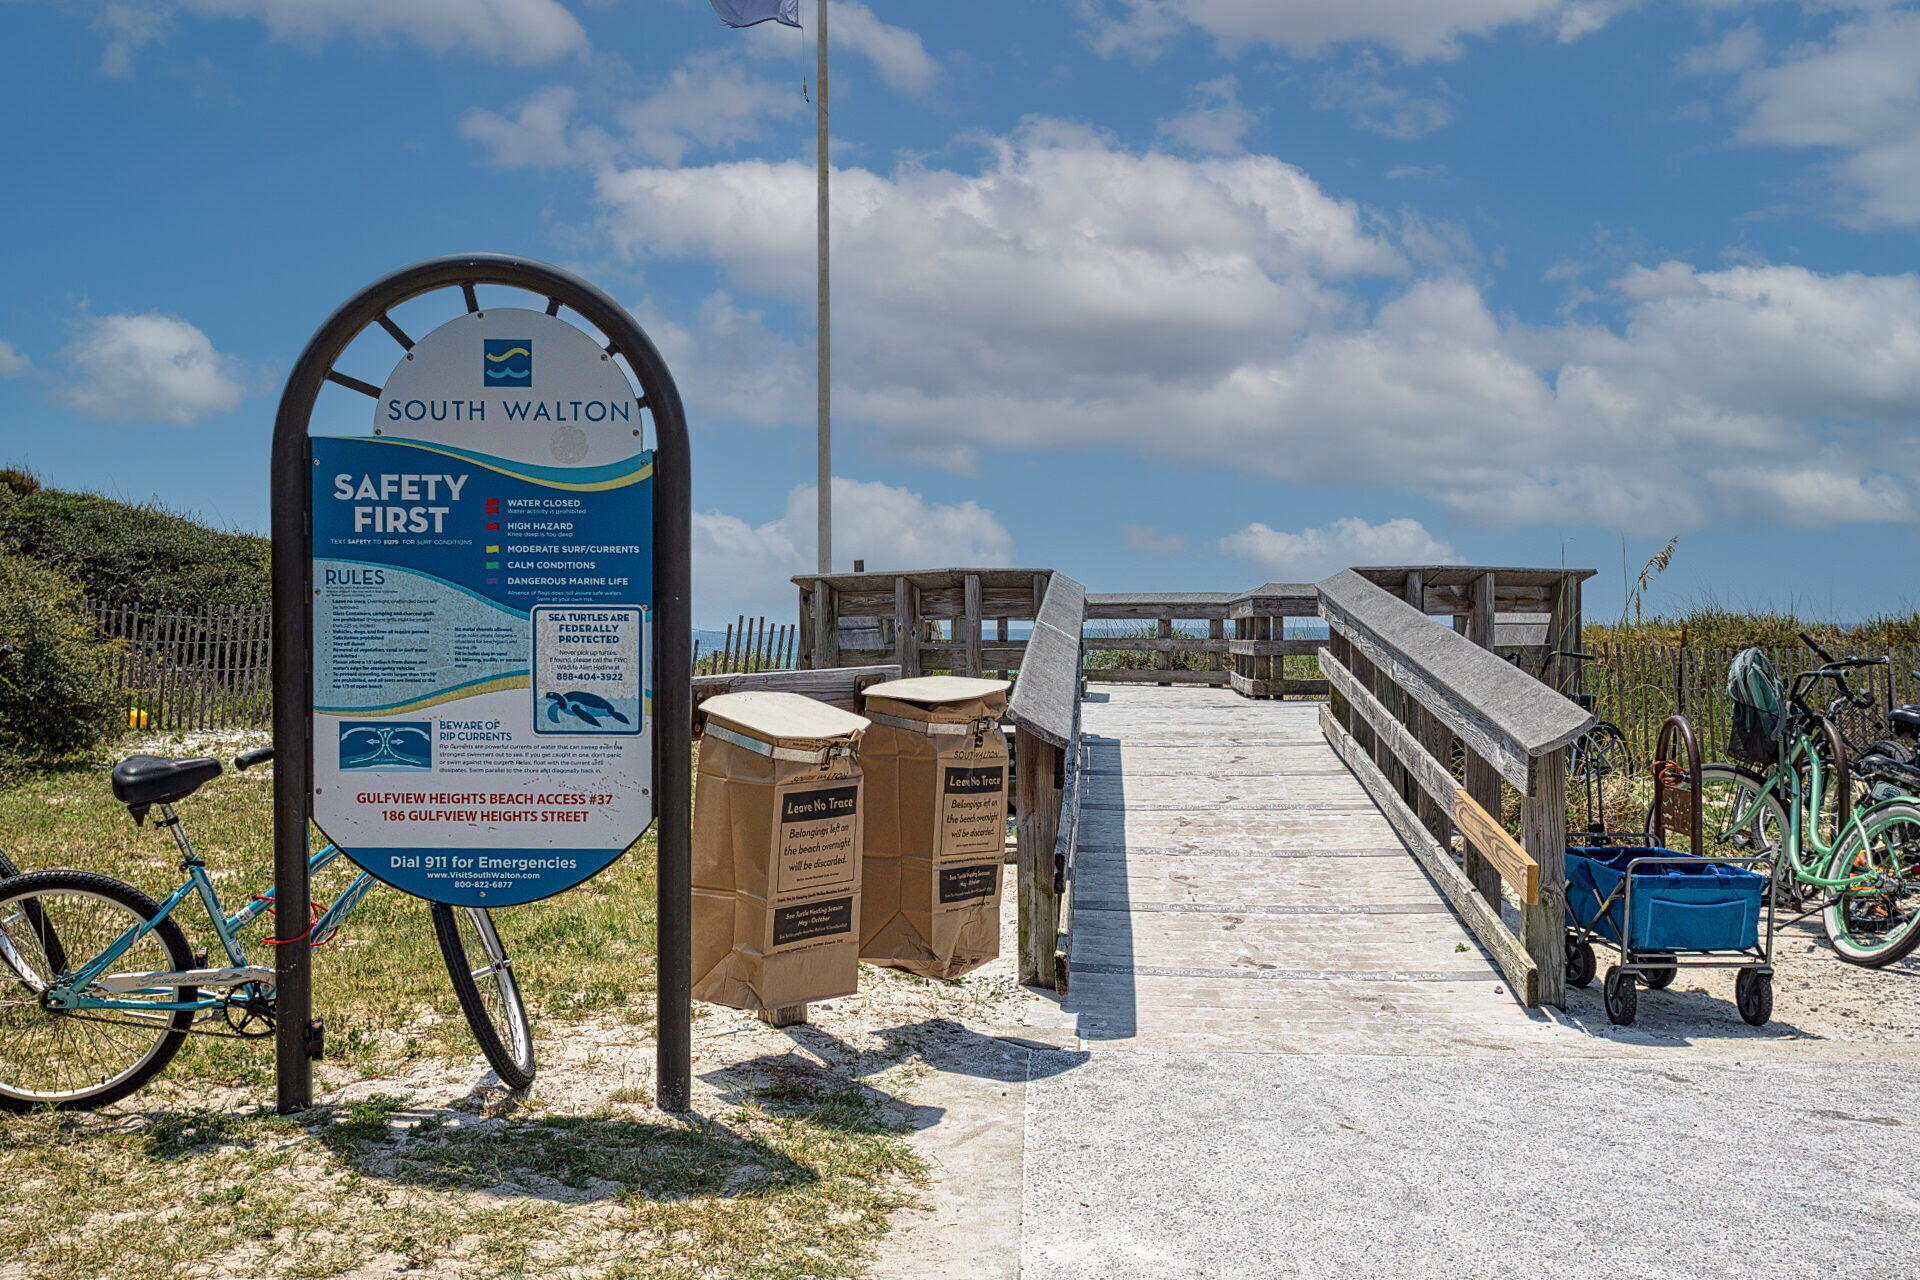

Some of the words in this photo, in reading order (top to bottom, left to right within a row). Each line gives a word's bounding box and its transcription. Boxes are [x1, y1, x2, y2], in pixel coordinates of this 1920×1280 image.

[388, 400, 485, 422] SOUTH
[502, 400, 630, 422] WALTON
[333, 474, 469, 500] SAFETY
[355, 507, 449, 533] FIRST
[507, 522, 531, 530] HIGH
[533, 522, 573, 530] HAZARD
[507, 545, 559, 554] MODERATE
[562, 545, 640, 554] SURF/CURRENTS
[326, 569, 385, 584] RULES
[440, 721, 483, 729] BEWARE
[485, 721, 500, 729] OF
[440, 732, 455, 740] RIP
[458, 732, 512, 740] CURRENTS
[971, 776, 980, 786] No
[981, 775, 1000, 786] Trace
[356, 792, 426, 805] GULFVIEW
[429, 792, 486, 805] HEIGHTS
[489, 792, 533, 805] BEACH
[536, 792, 586, 805] ACCESS
[588, 792, 613, 805] #37
[787, 804, 812, 814] Leave
[814, 799, 826, 810] No
[829, 798, 853, 808] Trace
[951, 800, 982, 810] Belongings
[382, 810, 405, 823] 186
[408, 810, 478, 823] GULFVIEW
[480, 810, 538, 823] HEIGHTS
[541, 810, 589, 823] STREET
[947, 815, 958, 823] the
[789, 826, 829, 839] Belongings
[830, 823, 840, 834] left
[962, 829, 969, 837] be
[784, 846, 799, 856] the
[798, 842, 820, 854] beach
[822, 838, 851, 850] overnight
[390, 856, 420, 868] Dial
[424, 856, 448, 870] 911
[452, 856, 472, 868] for
[478, 856, 577, 870] Emergencies
[789, 860, 802, 871] will
[803, 860, 812, 870] be
[427, 871, 540, 880] www.VisitSouthWalton.com
[454, 881, 513, 889] 800-822-6877
